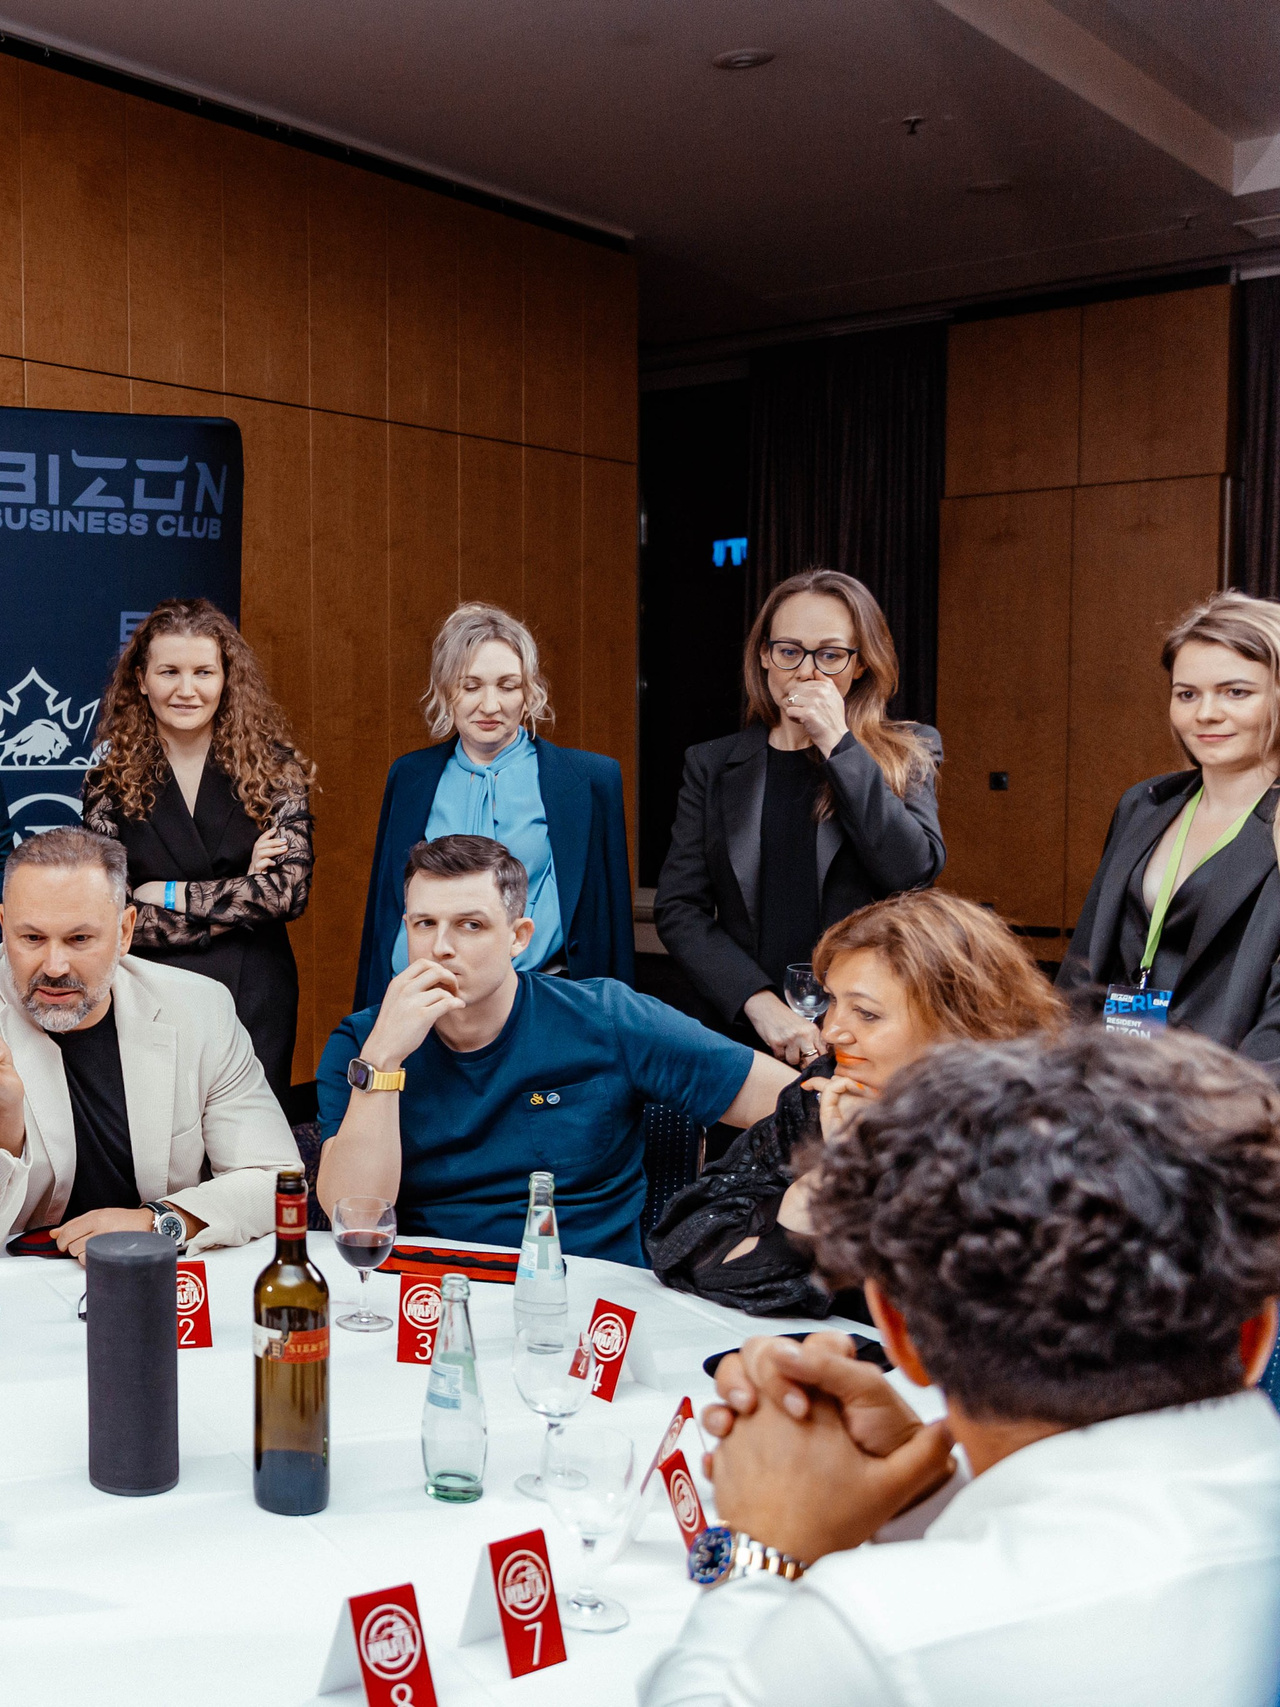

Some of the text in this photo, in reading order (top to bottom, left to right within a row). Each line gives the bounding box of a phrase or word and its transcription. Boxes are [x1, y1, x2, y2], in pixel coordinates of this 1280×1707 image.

[156, 514, 221, 540] CLUB
[1106, 1017, 1142, 1027] RESIDENT
[179, 1318, 196, 1345] 2
[415, 1333, 432, 1360] 3
[524, 1621, 543, 1666] 7
